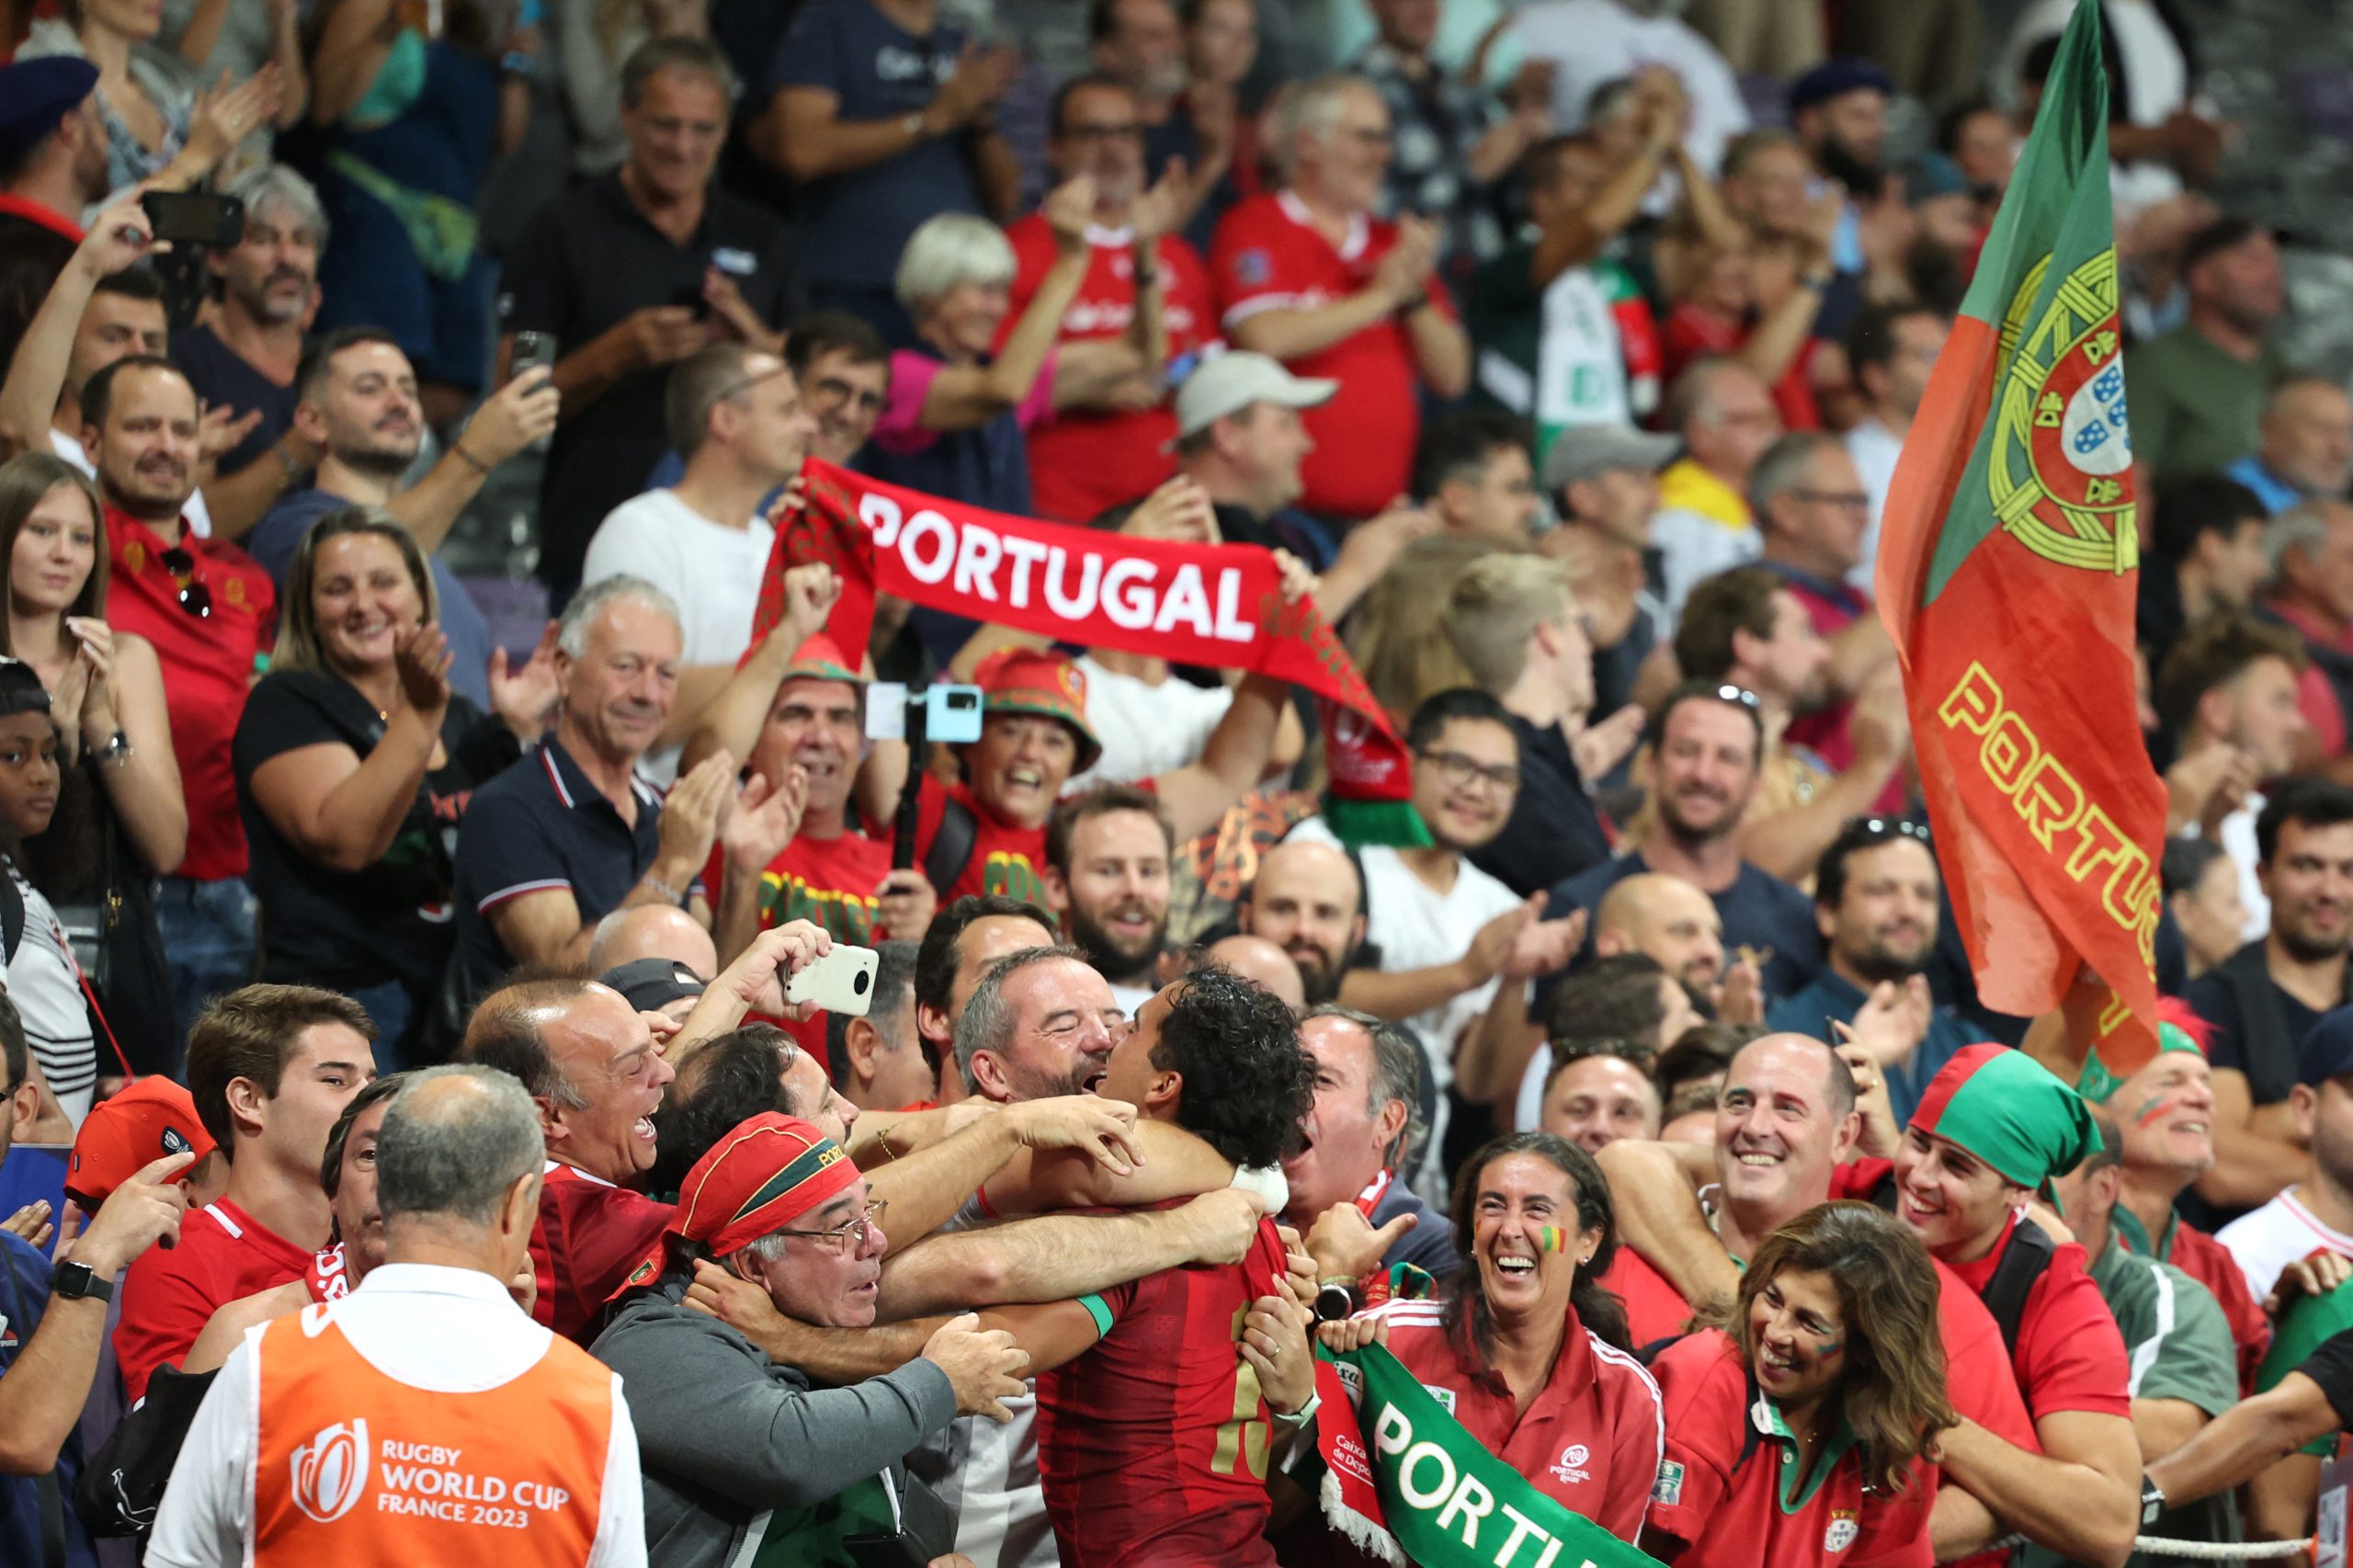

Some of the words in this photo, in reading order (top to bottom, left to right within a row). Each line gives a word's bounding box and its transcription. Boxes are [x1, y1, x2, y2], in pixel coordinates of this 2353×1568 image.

[858, 493, 1256, 642] PORTUGAL
[382, 1439, 461, 1467] RUGBY
[1333, 1448, 1345, 1461] de
[1336, 1435, 1367, 1459] Caixa
[1550, 1465, 1590, 1480] PORTUGAL
[381, 1463, 506, 1502] WORLD
[513, 1482, 570, 1511] CUP
[378, 1493, 466, 1522] FRANCE
[472, 1506, 529, 1529] 2023
